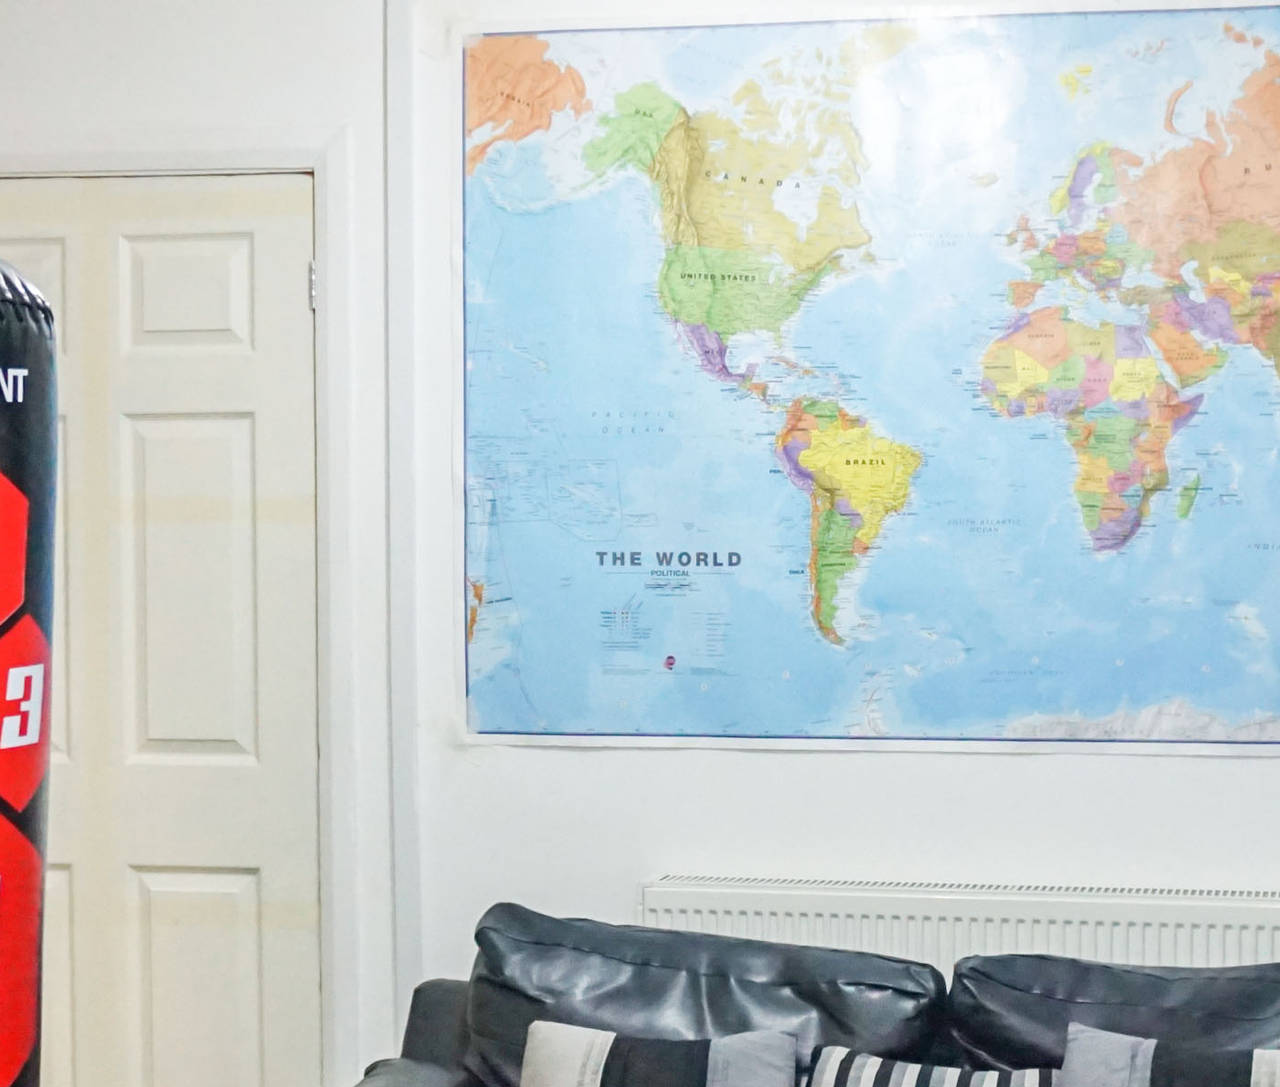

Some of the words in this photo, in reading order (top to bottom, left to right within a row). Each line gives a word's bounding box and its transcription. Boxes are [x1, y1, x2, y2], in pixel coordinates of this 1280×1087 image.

[705, 170, 801, 188] CANADA
[680, 273, 716, 281] UNITED
[720, 274, 756, 282] STATES
[845, 458, 886, 466] BRAZIL
[595, 552, 642, 567] THE
[656, 551, 742, 567] WORLD
[650, 570, 691, 578] POLITICAL
